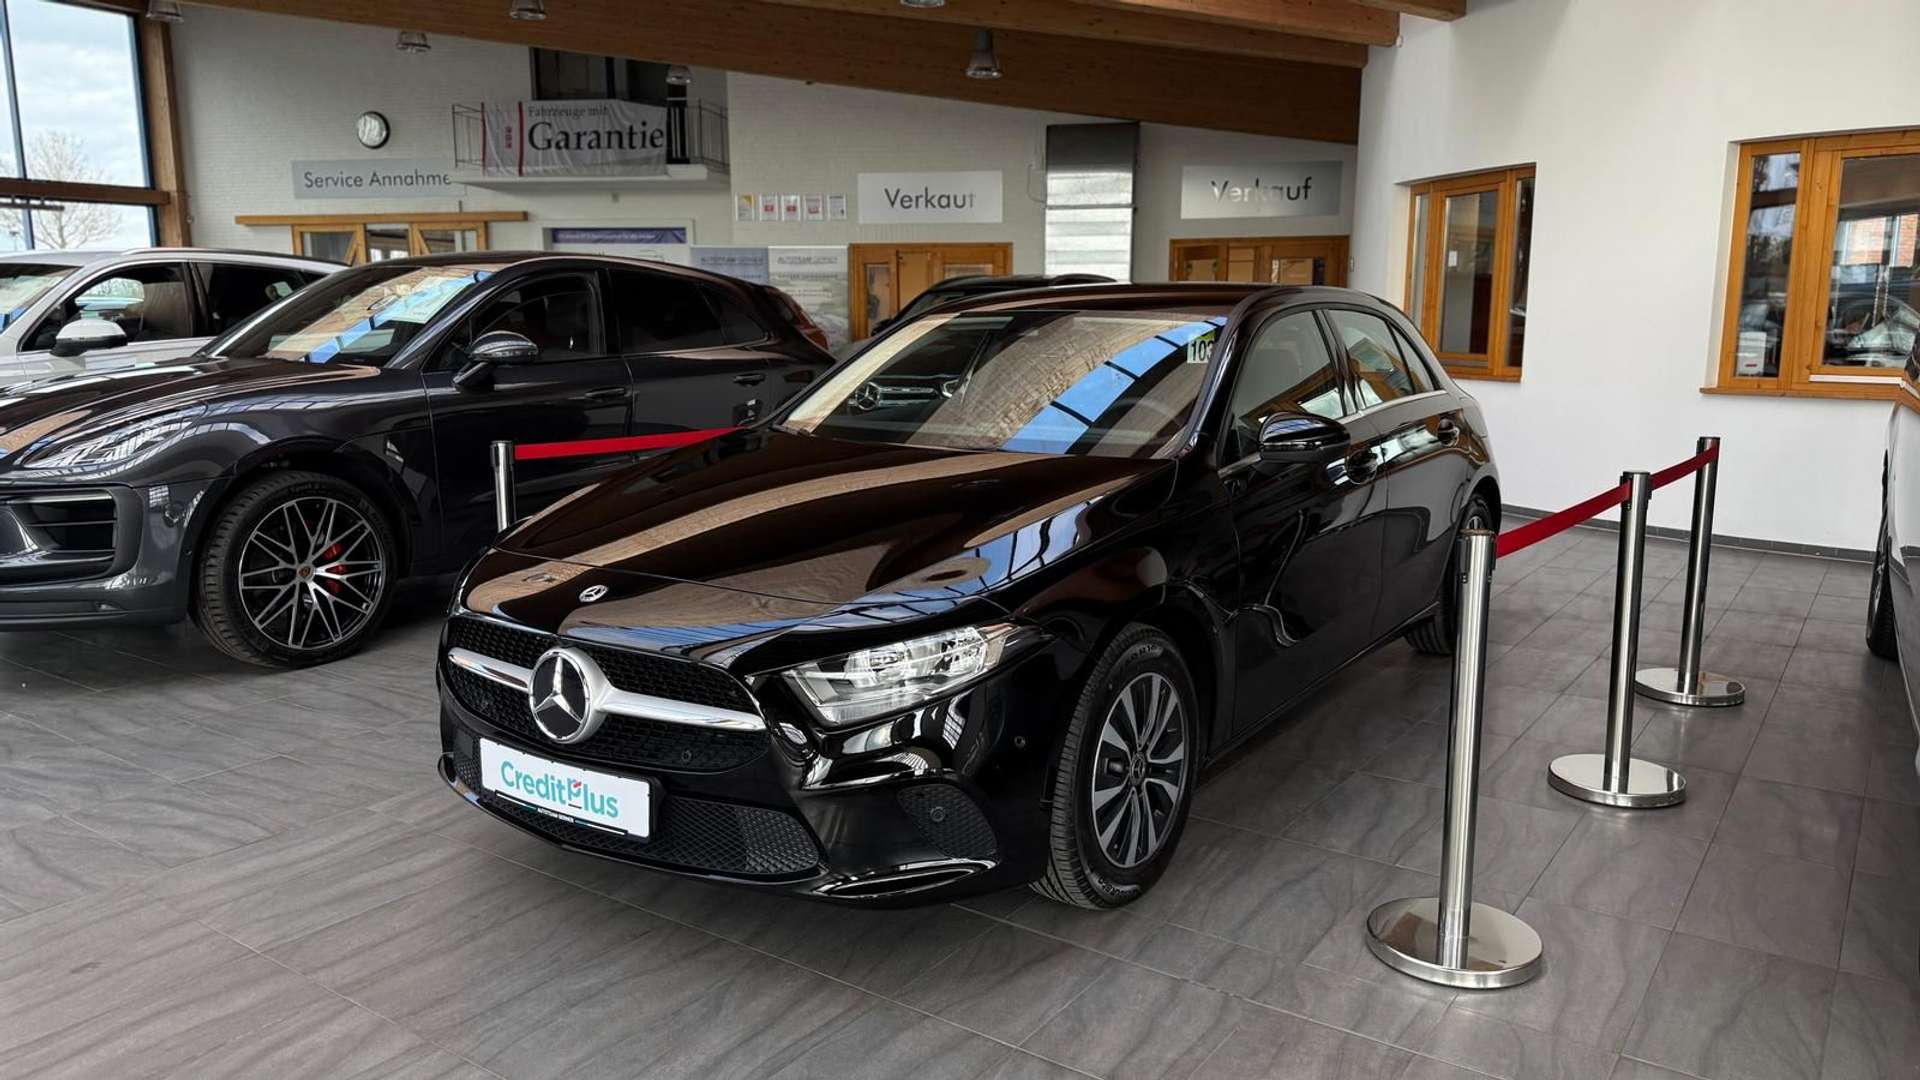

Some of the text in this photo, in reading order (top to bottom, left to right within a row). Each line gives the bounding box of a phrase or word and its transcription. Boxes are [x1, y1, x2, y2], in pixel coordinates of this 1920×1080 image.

[527, 120, 665, 151] Garantie
[303, 168, 453, 189] Service Annahme
[1210, 175, 1313, 203] Verkauf
[501, 760, 619, 818] CreditPlus
